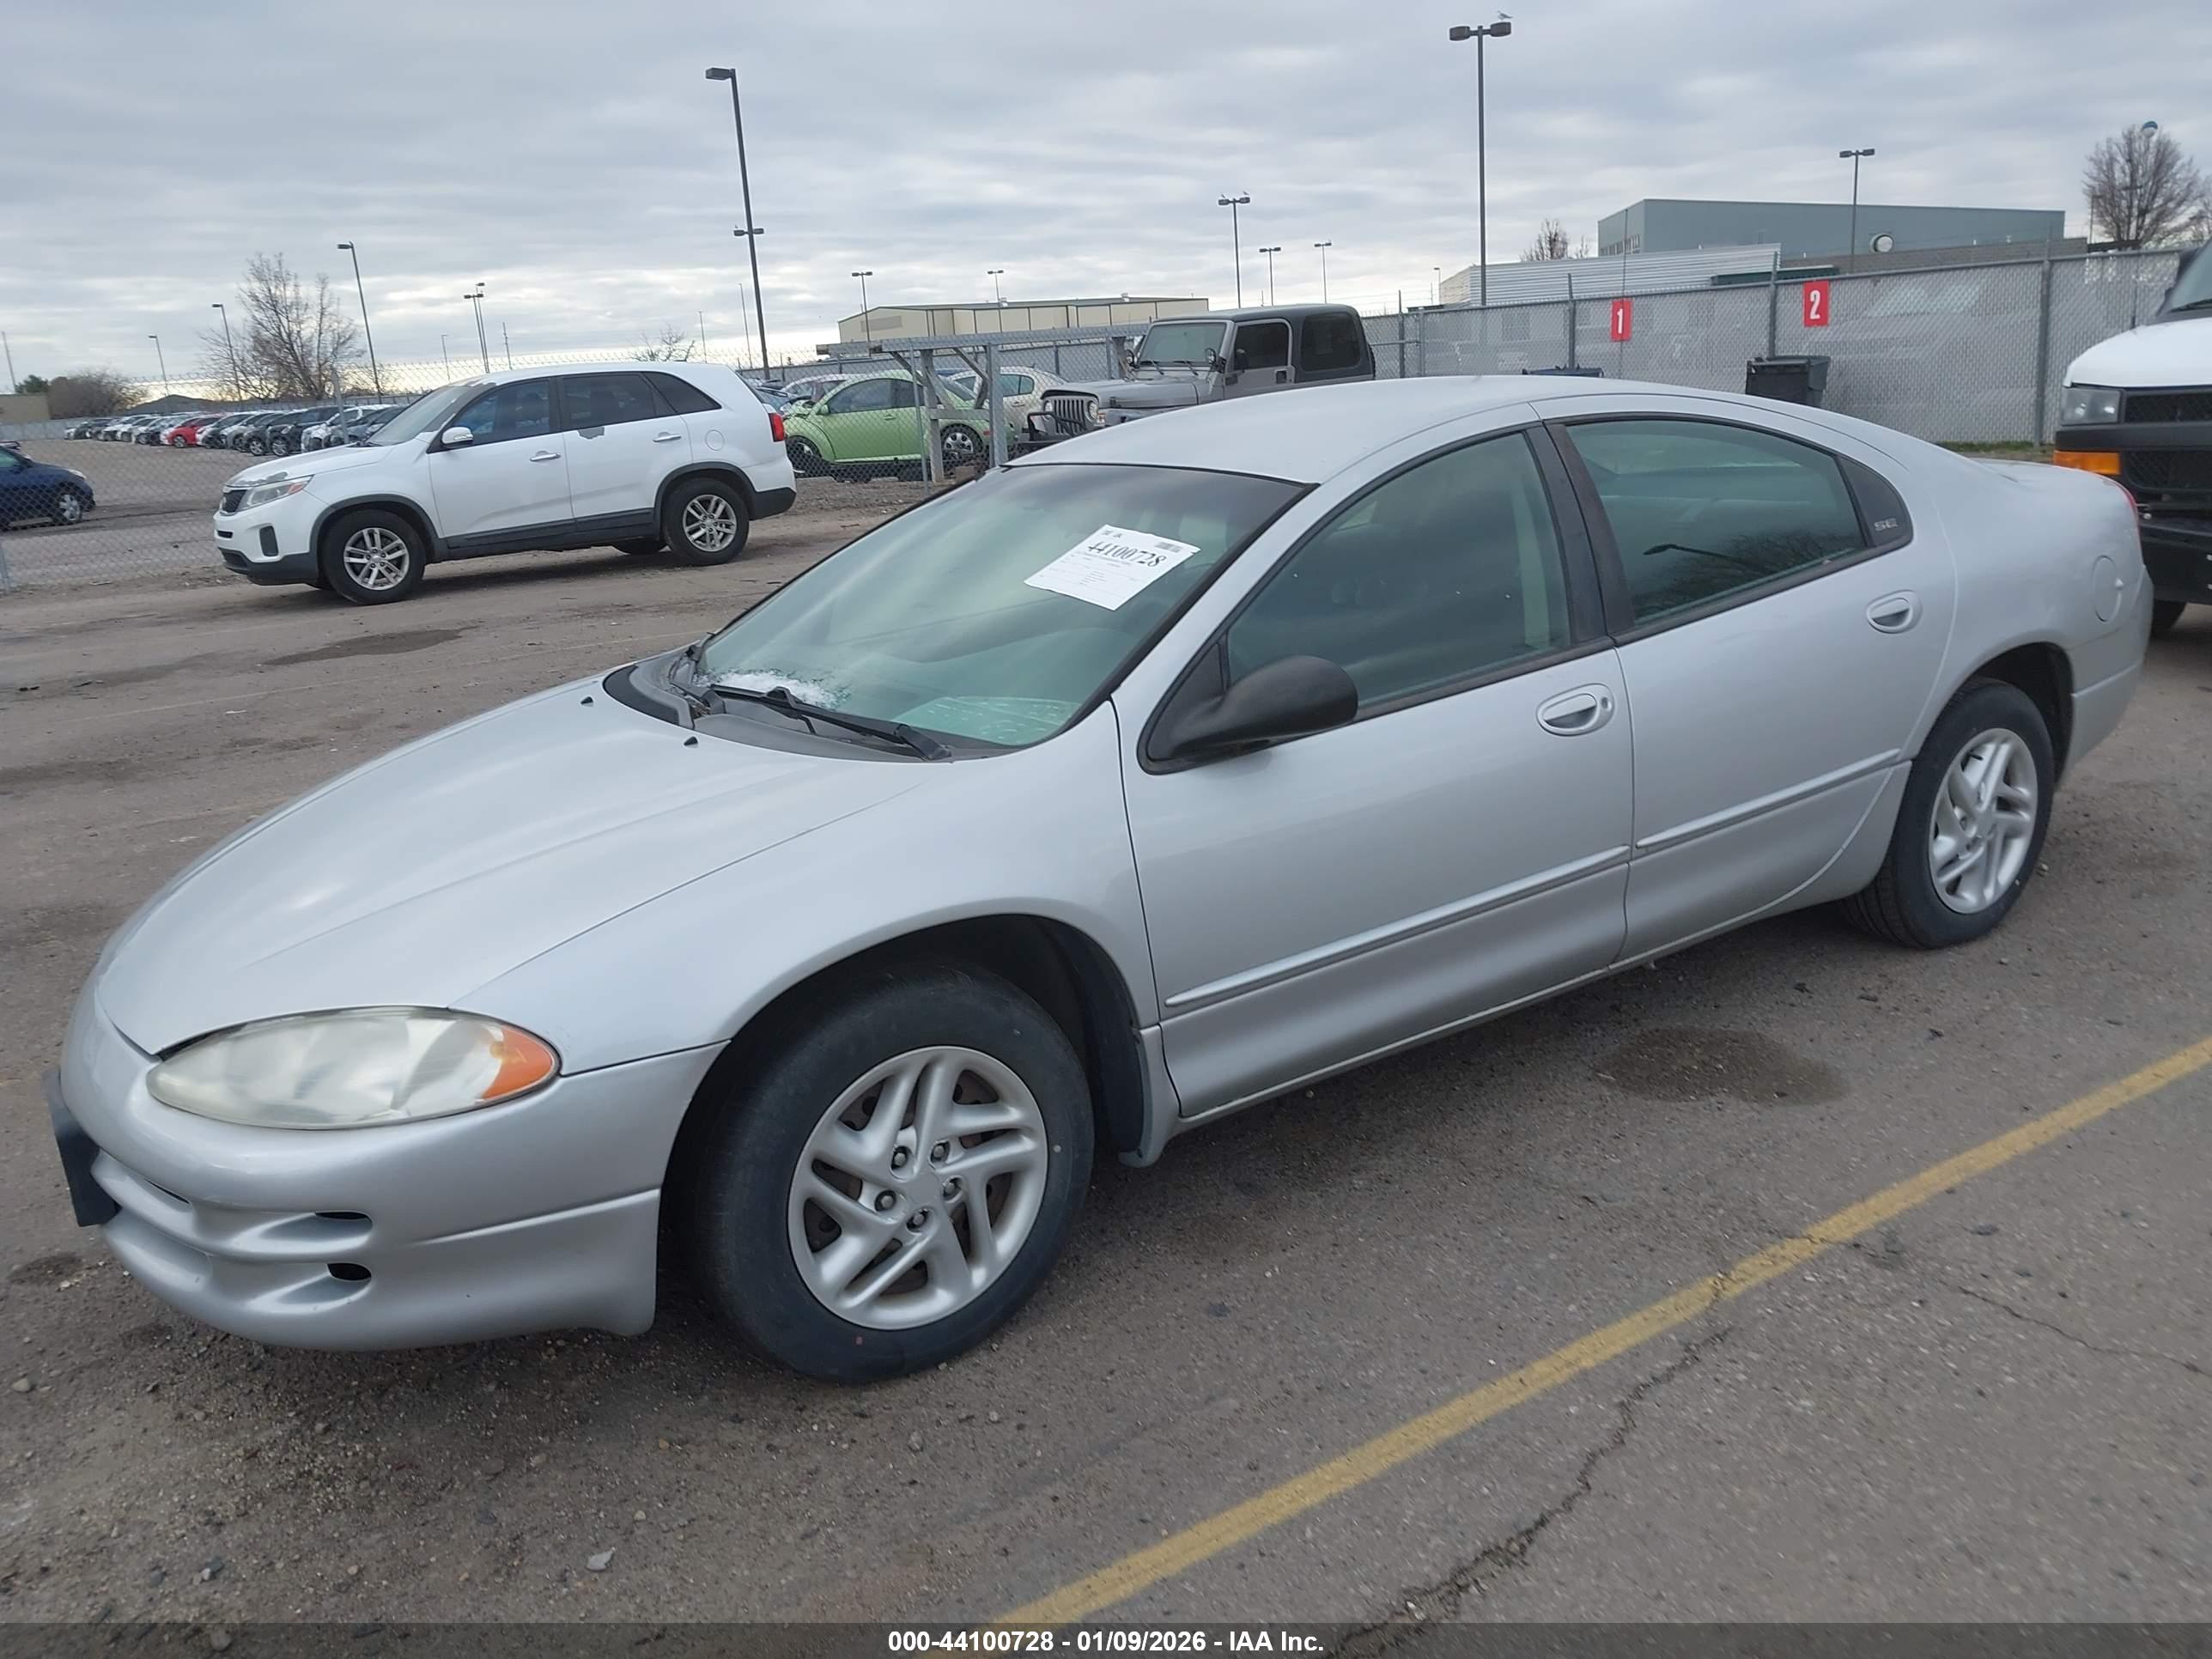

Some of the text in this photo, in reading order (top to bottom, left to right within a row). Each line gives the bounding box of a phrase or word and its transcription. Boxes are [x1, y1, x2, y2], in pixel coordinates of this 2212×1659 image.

[1809, 289, 1821, 320] 2
[1617, 307, 1624, 335] 1
[1088, 541, 1167, 567] 44100728
